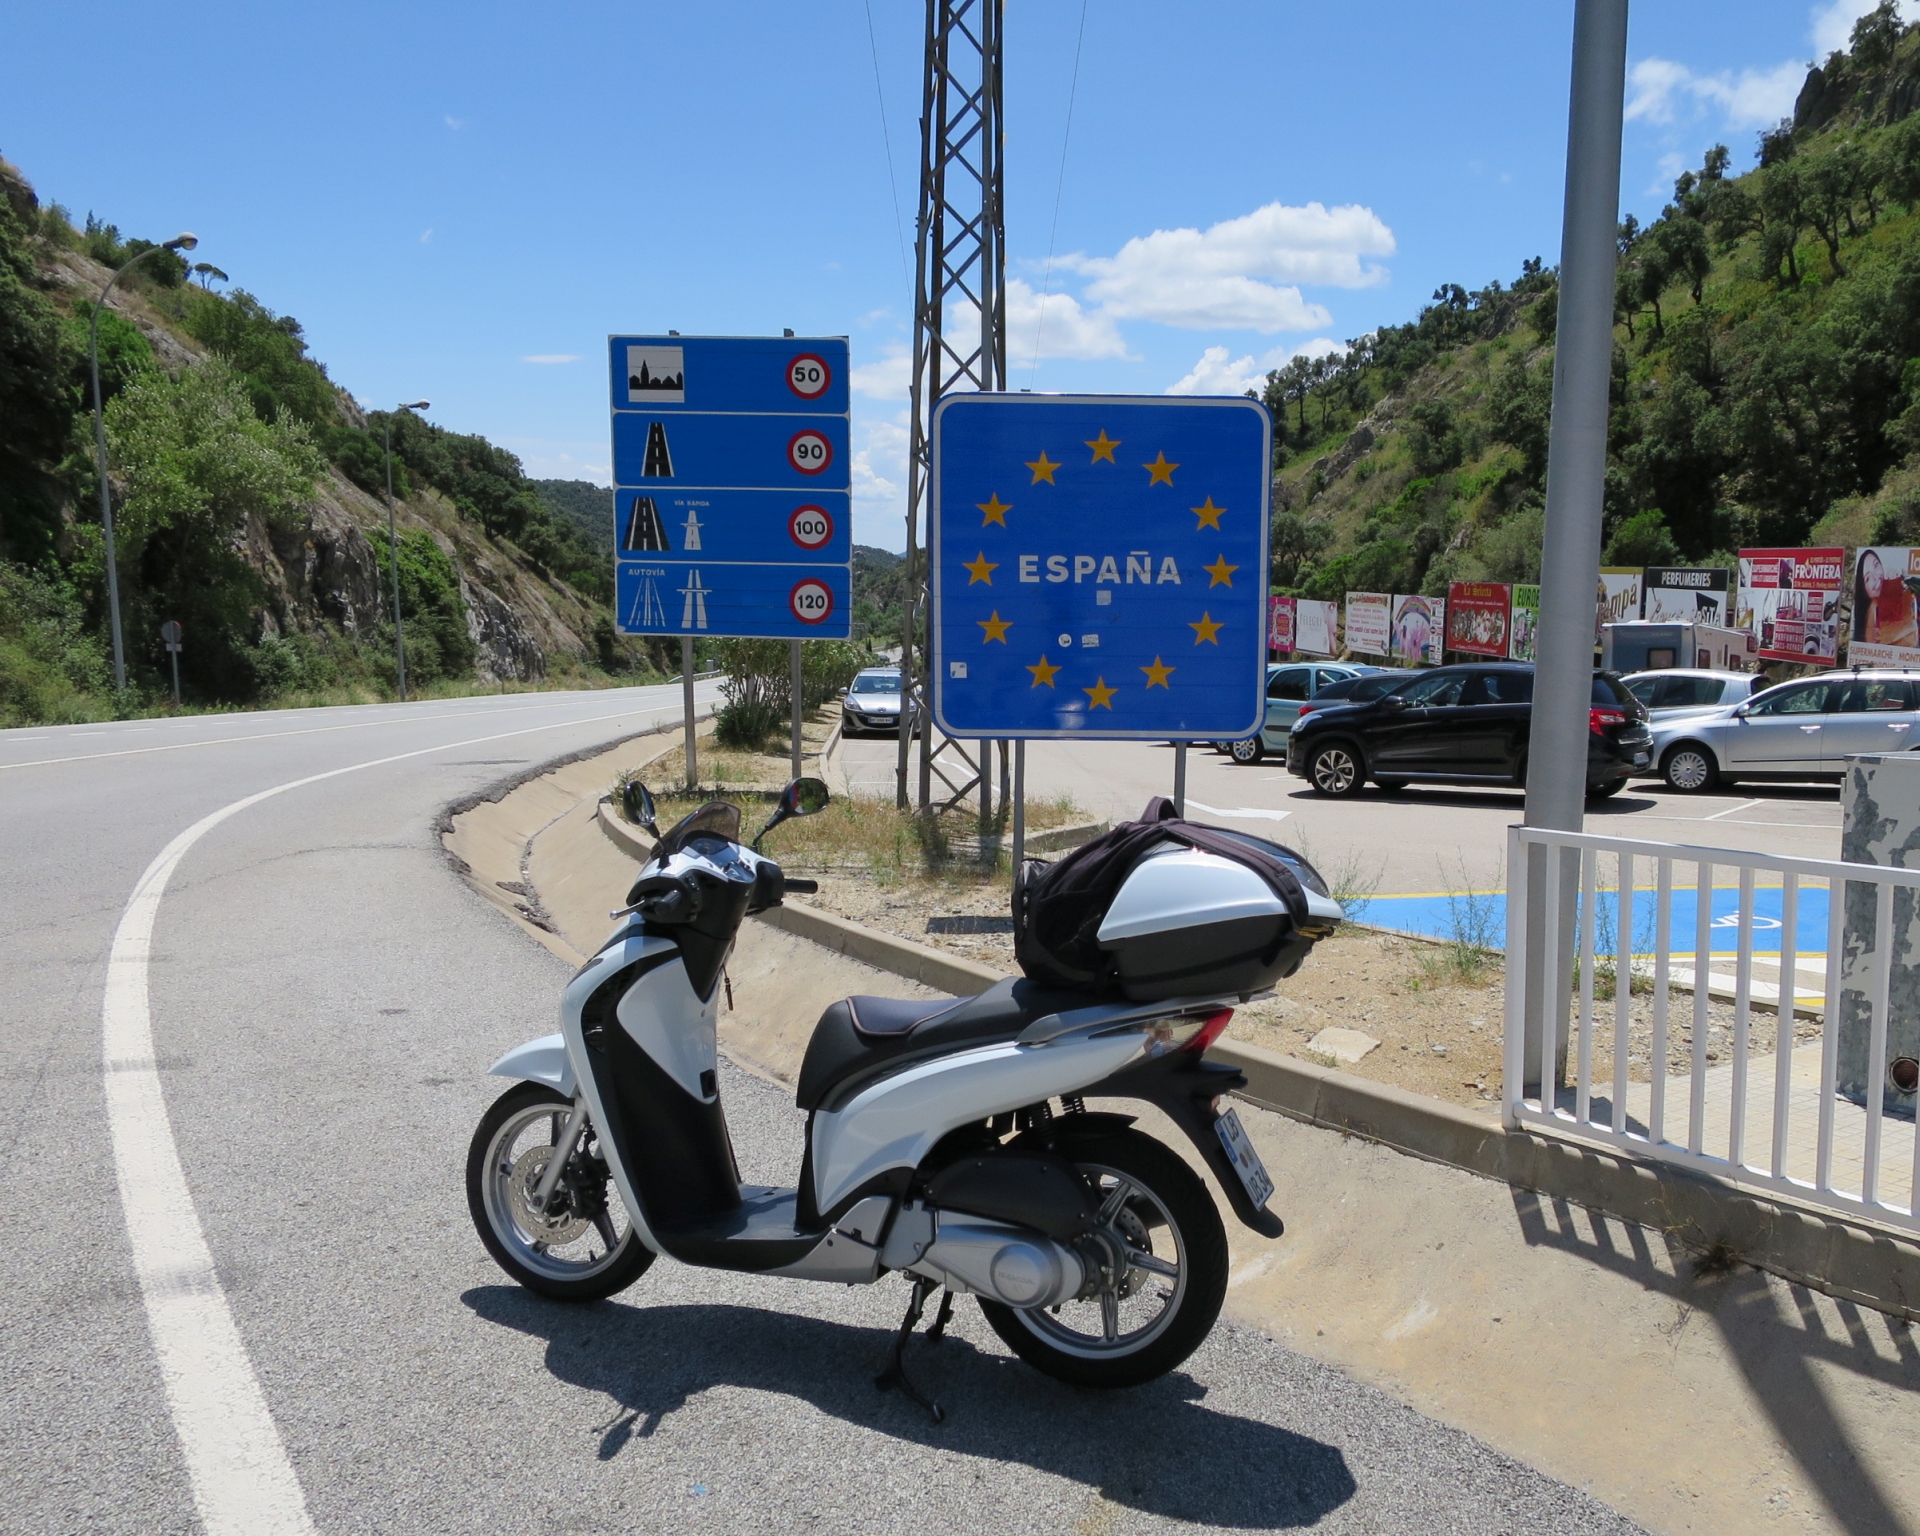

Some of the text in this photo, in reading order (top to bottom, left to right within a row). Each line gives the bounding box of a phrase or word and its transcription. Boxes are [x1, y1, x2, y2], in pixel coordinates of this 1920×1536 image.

[794, 366, 820, 383] 50
[797, 443, 823, 460] 90
[795, 520, 826, 535] 100
[628, 568, 666, 576] AUTOVÍA
[1019, 551, 1181, 584] ESPAÑA
[1795, 564, 1841, 579] FRONTERA
[1661, 571, 1711, 587] PERFUMERIES
[1463, 585, 1471, 596] La
[797, 594, 825, 610] 120
